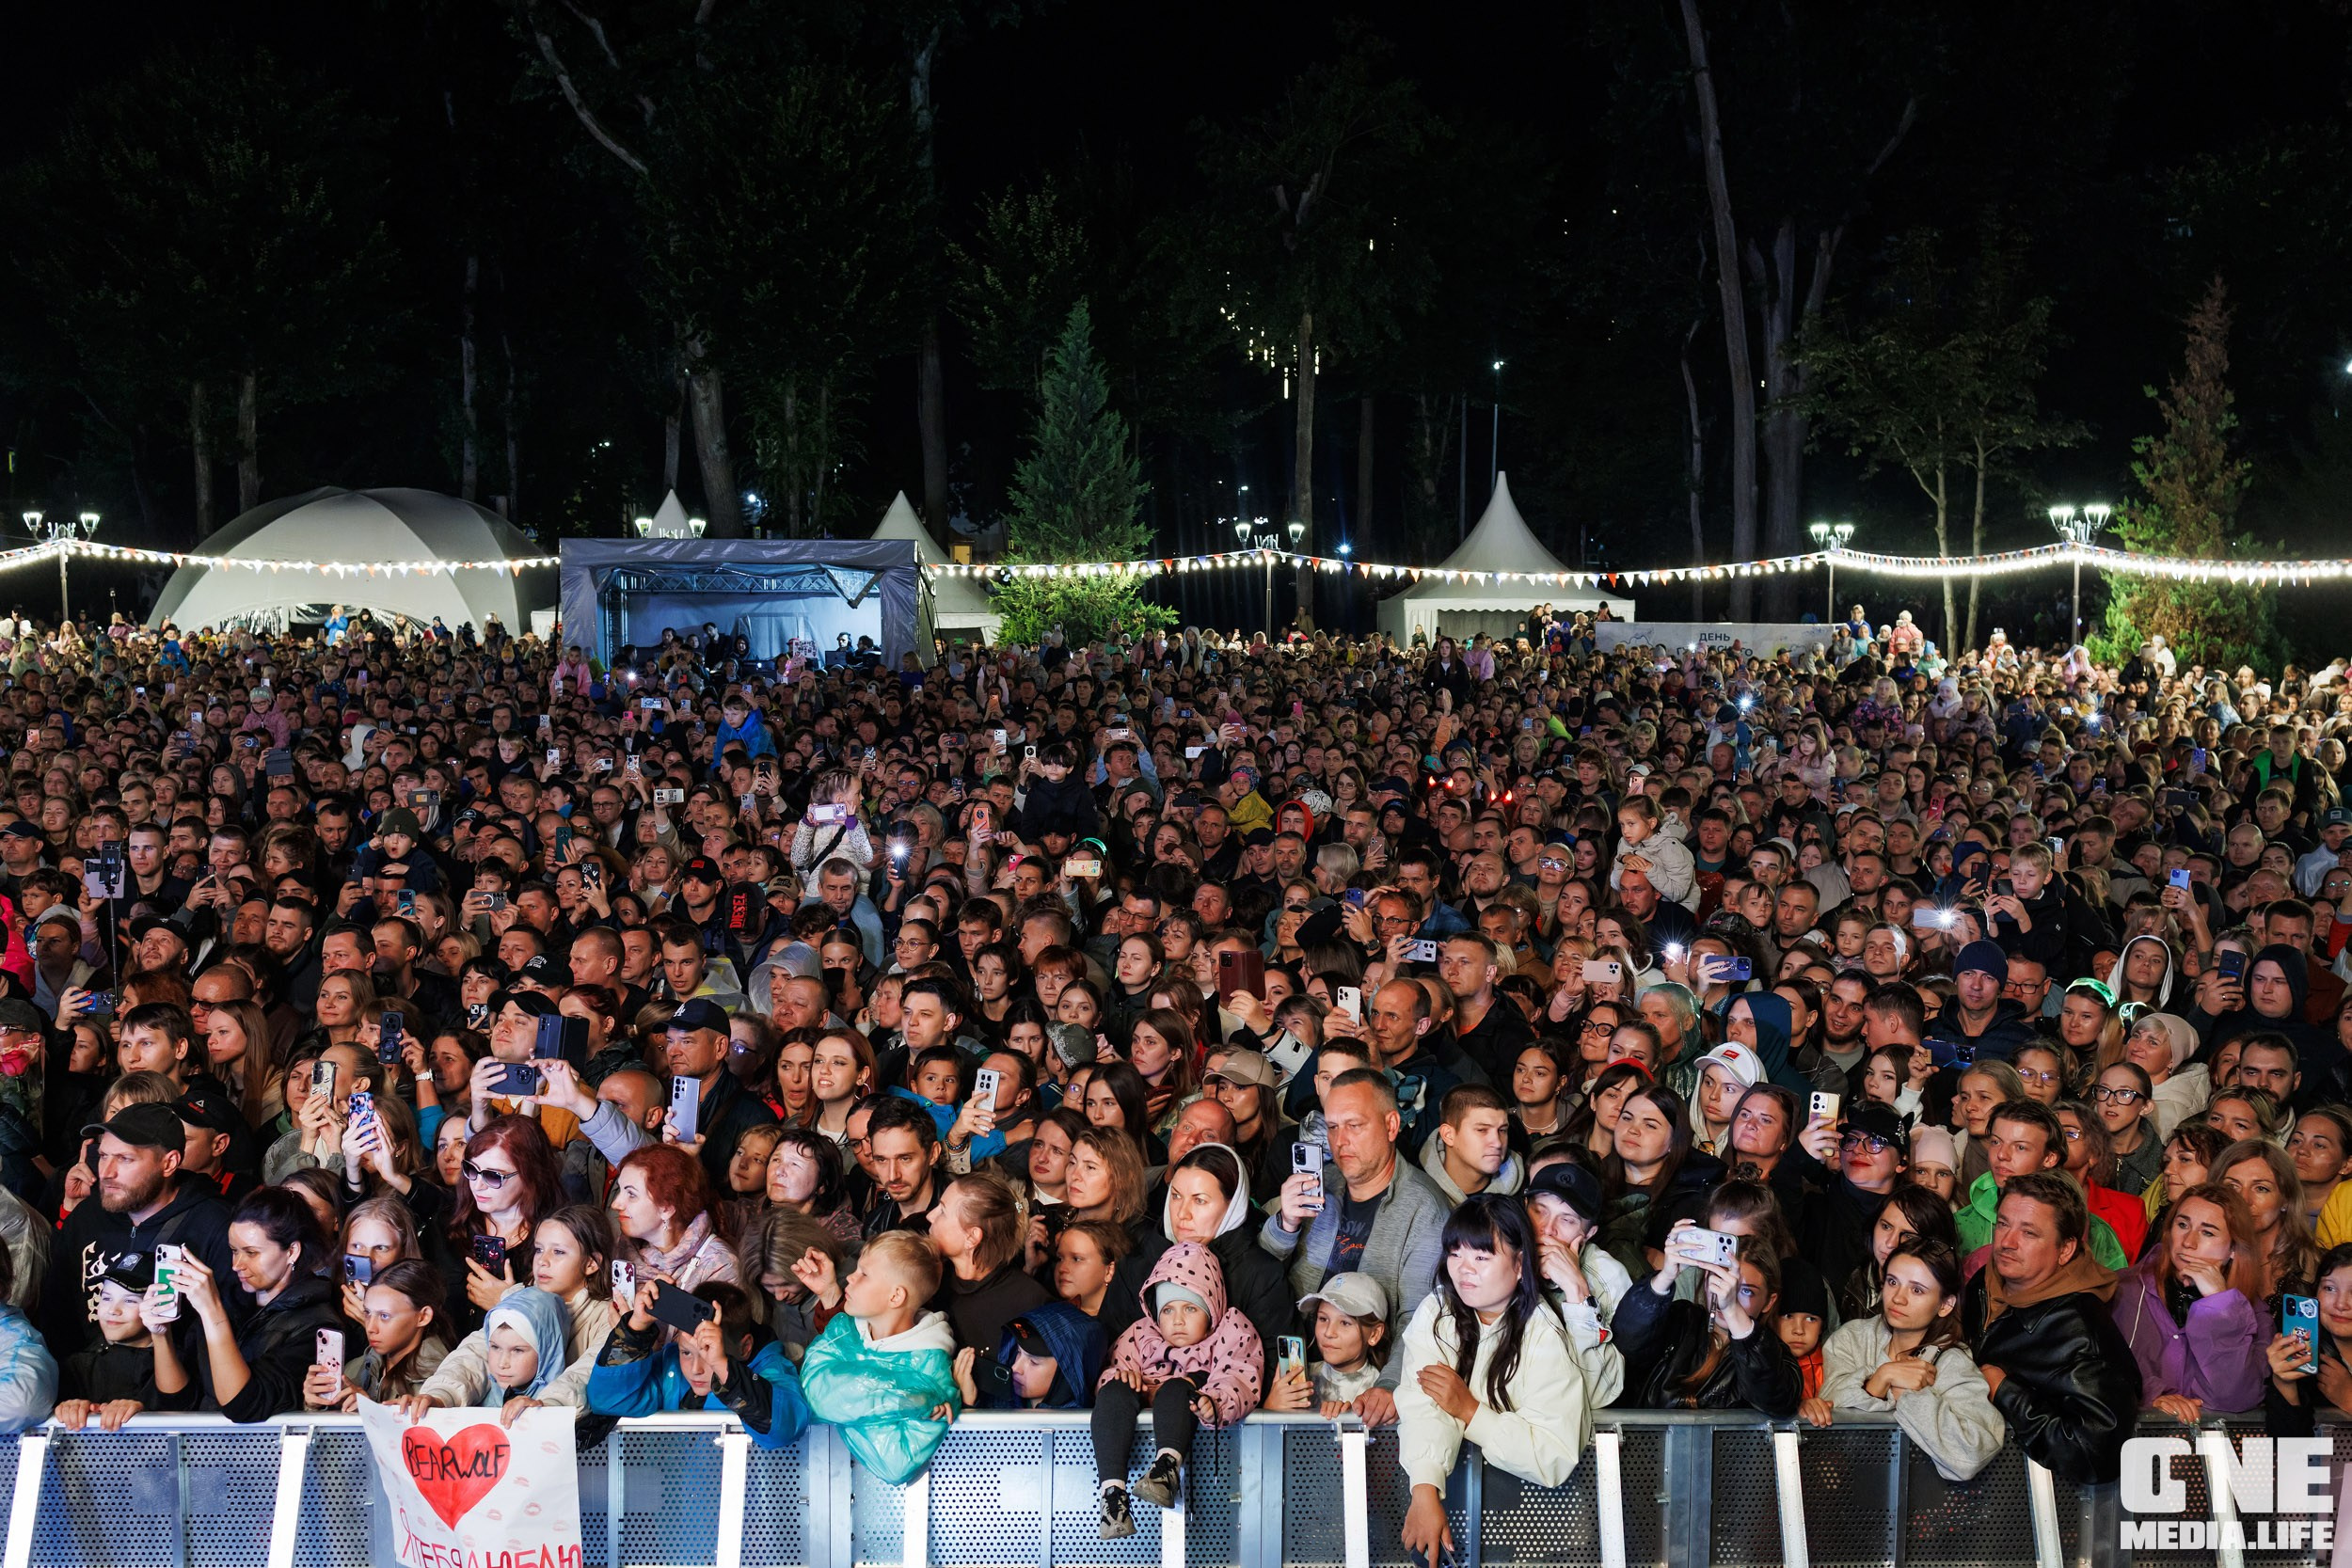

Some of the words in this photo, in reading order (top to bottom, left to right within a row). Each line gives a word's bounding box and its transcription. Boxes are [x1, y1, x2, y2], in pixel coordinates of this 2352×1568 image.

[1699, 633, 1730, 641] ДЕНЬ
[730, 894, 746, 929] DIESEL
[405, 1436, 510, 1481] BEARWOLF
